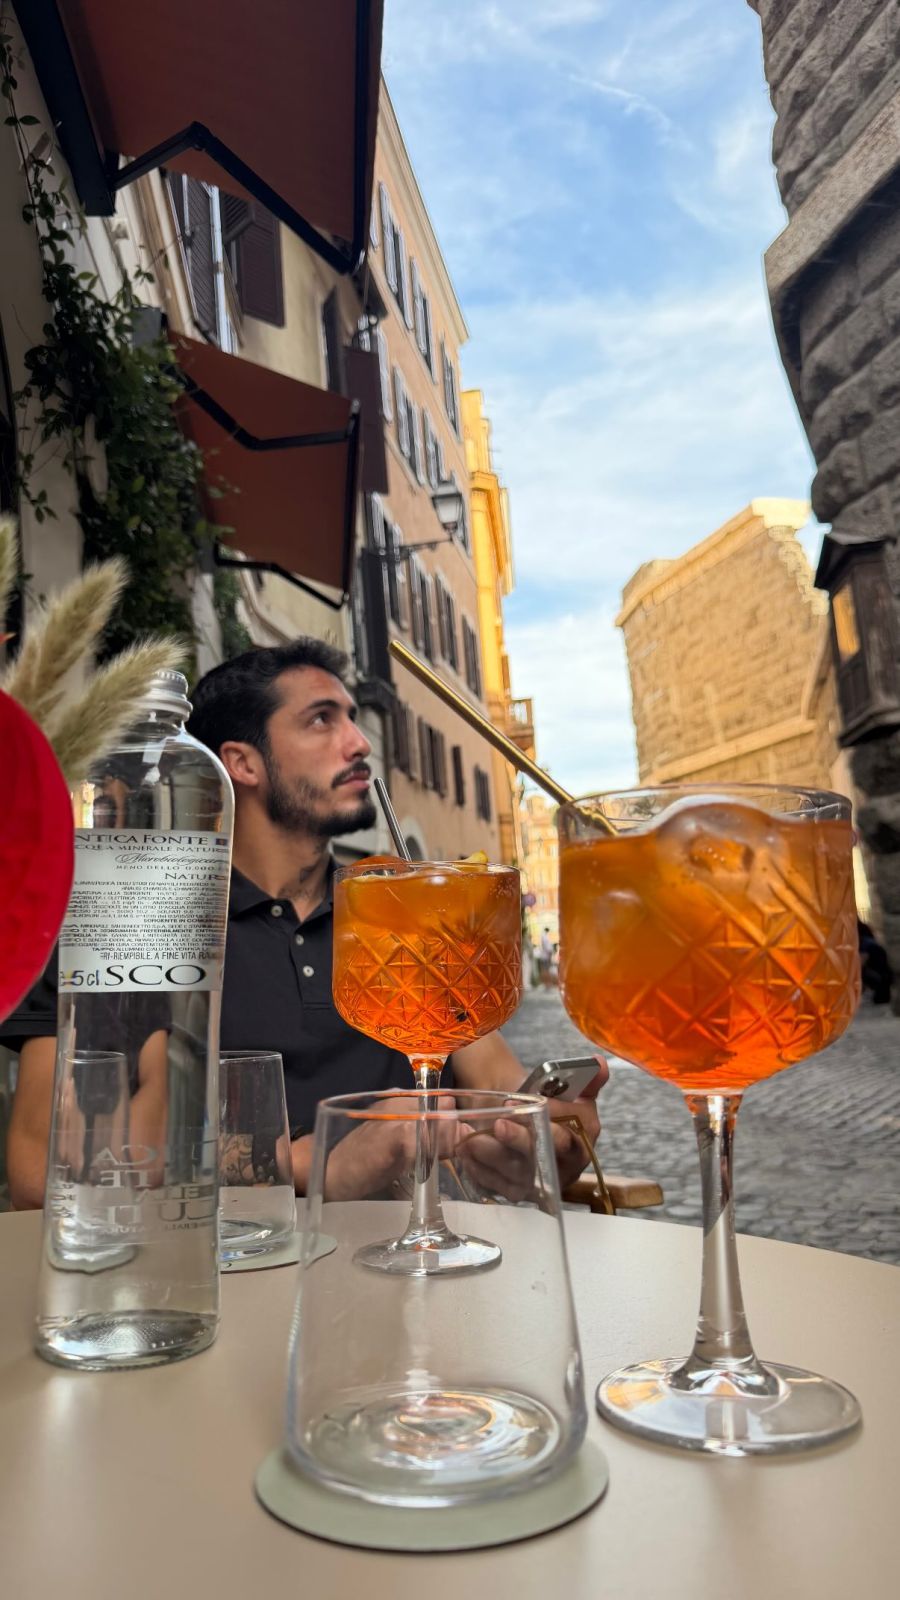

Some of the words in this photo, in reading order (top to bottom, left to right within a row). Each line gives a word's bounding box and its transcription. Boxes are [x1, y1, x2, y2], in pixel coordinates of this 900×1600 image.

[74, 834, 138, 844] NTICA
[143, 834, 208, 845] FONTE
[115, 853, 228, 866] Microbiologica
[165, 872, 226, 881] NATUR
[153, 952, 160, 960] A
[161, 952, 179, 960] FINE
[180, 952, 197, 960] VITA
[104, 964, 207, 986] SCO
